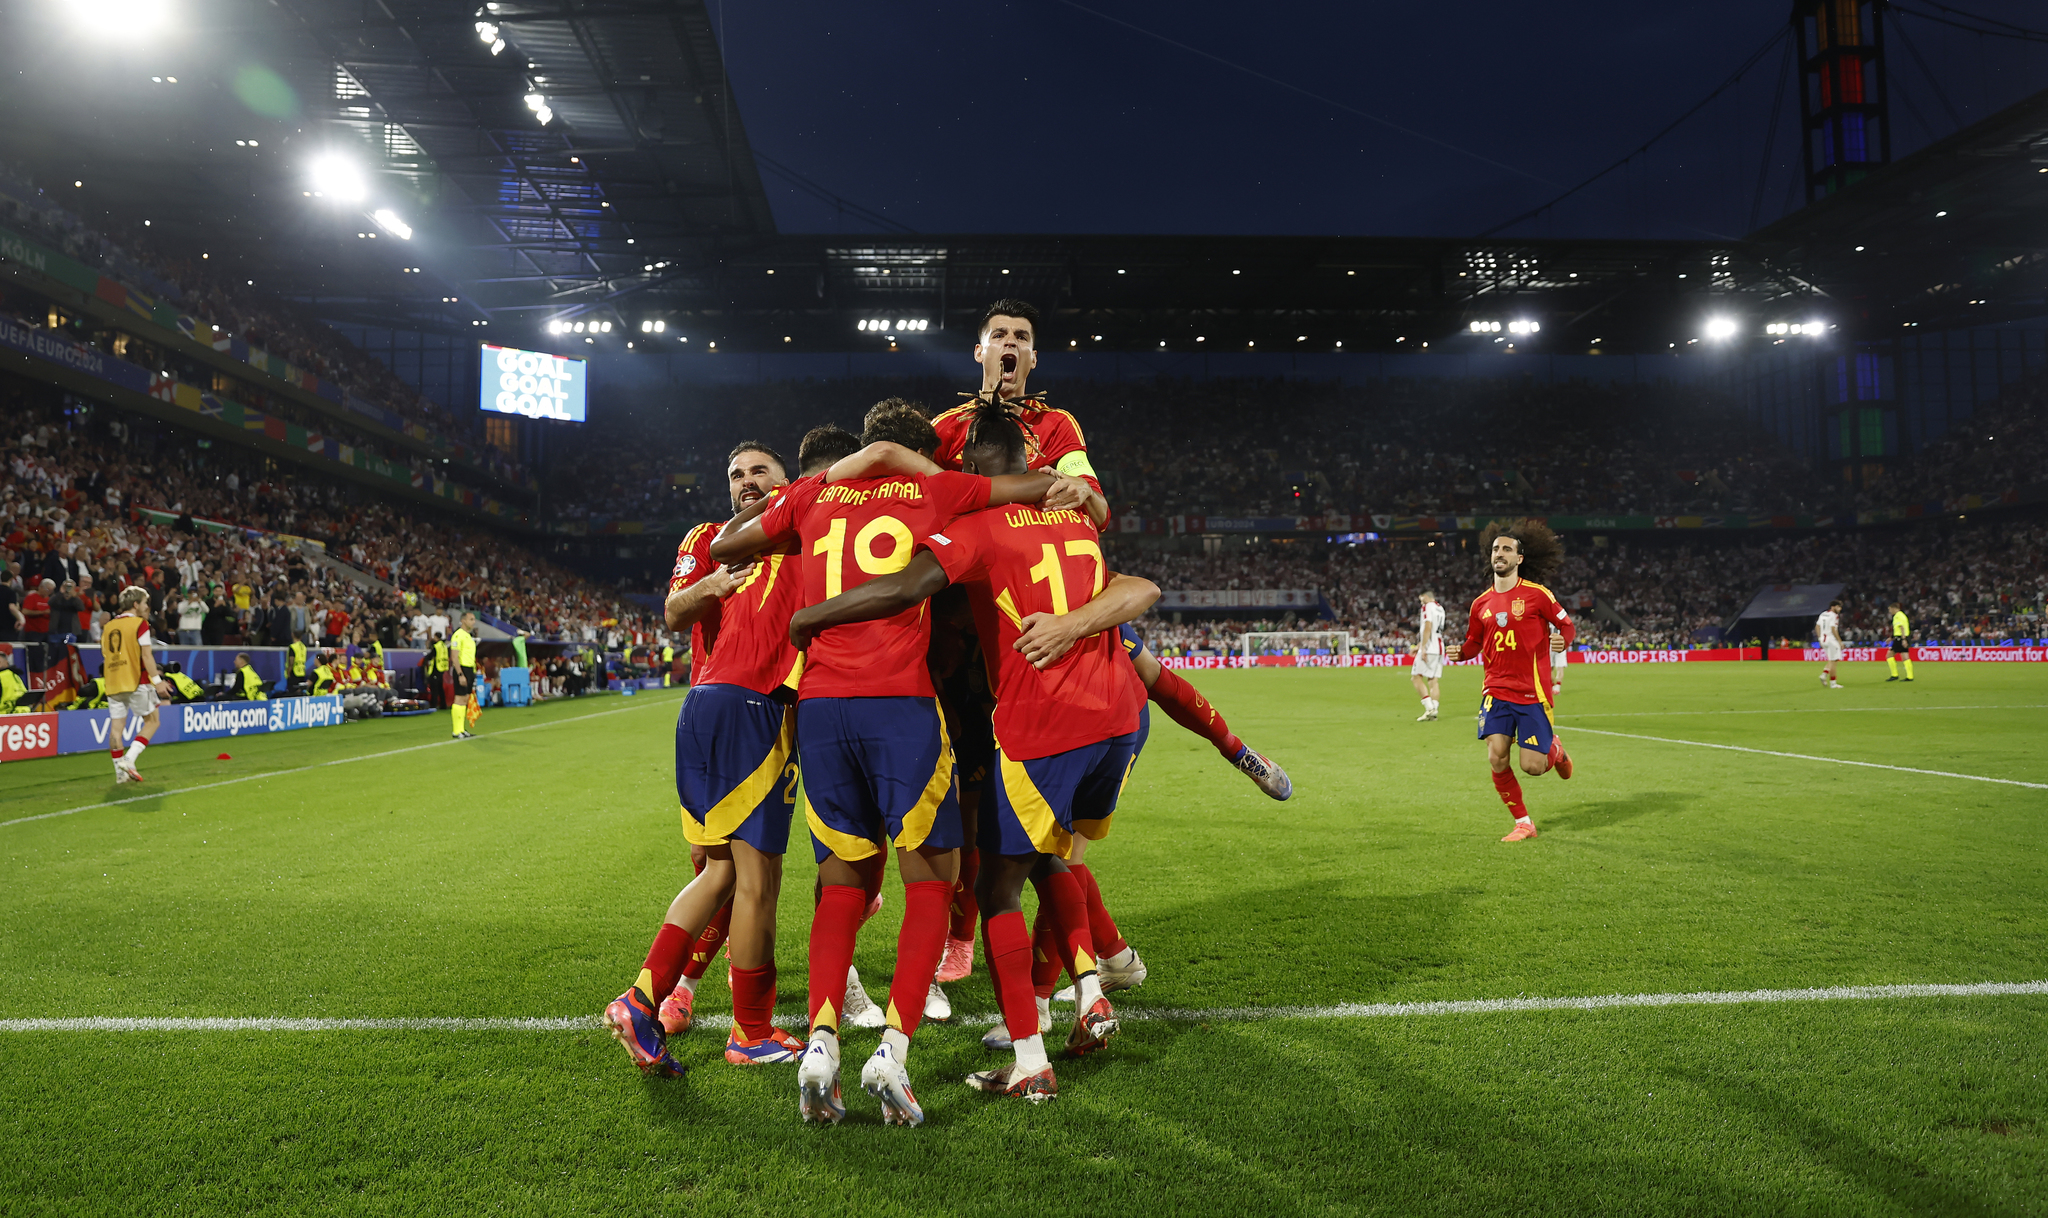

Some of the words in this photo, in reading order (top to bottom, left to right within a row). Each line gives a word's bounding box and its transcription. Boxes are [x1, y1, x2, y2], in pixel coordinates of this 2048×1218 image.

[1, 237, 46, 272] KÖLN
[497, 350, 572, 381] GOAL
[500, 372, 569, 399] GOAL
[496, 391, 571, 421] GOAL
[1004, 509, 1082, 528] WILLIAMS
[1585, 518, 1616, 527] KÖLN
[813, 515, 914, 600] 19
[1029, 539, 1104, 636] 17
[1190, 590, 1277, 606] BELIEVE
[1494, 630, 1517, 652] 24
[1917, 648, 1940, 661] One
[1940, 647, 1973, 661] World
[1974, 647, 2024, 661] Account
[2025, 647, 2043, 661] for
[1583, 650, 1688, 664] WORLDFIRST
[1803, 648, 1877, 662] WORFIRST
[183, 704, 268, 735] Booking.com
[783, 762, 800, 804] 2
